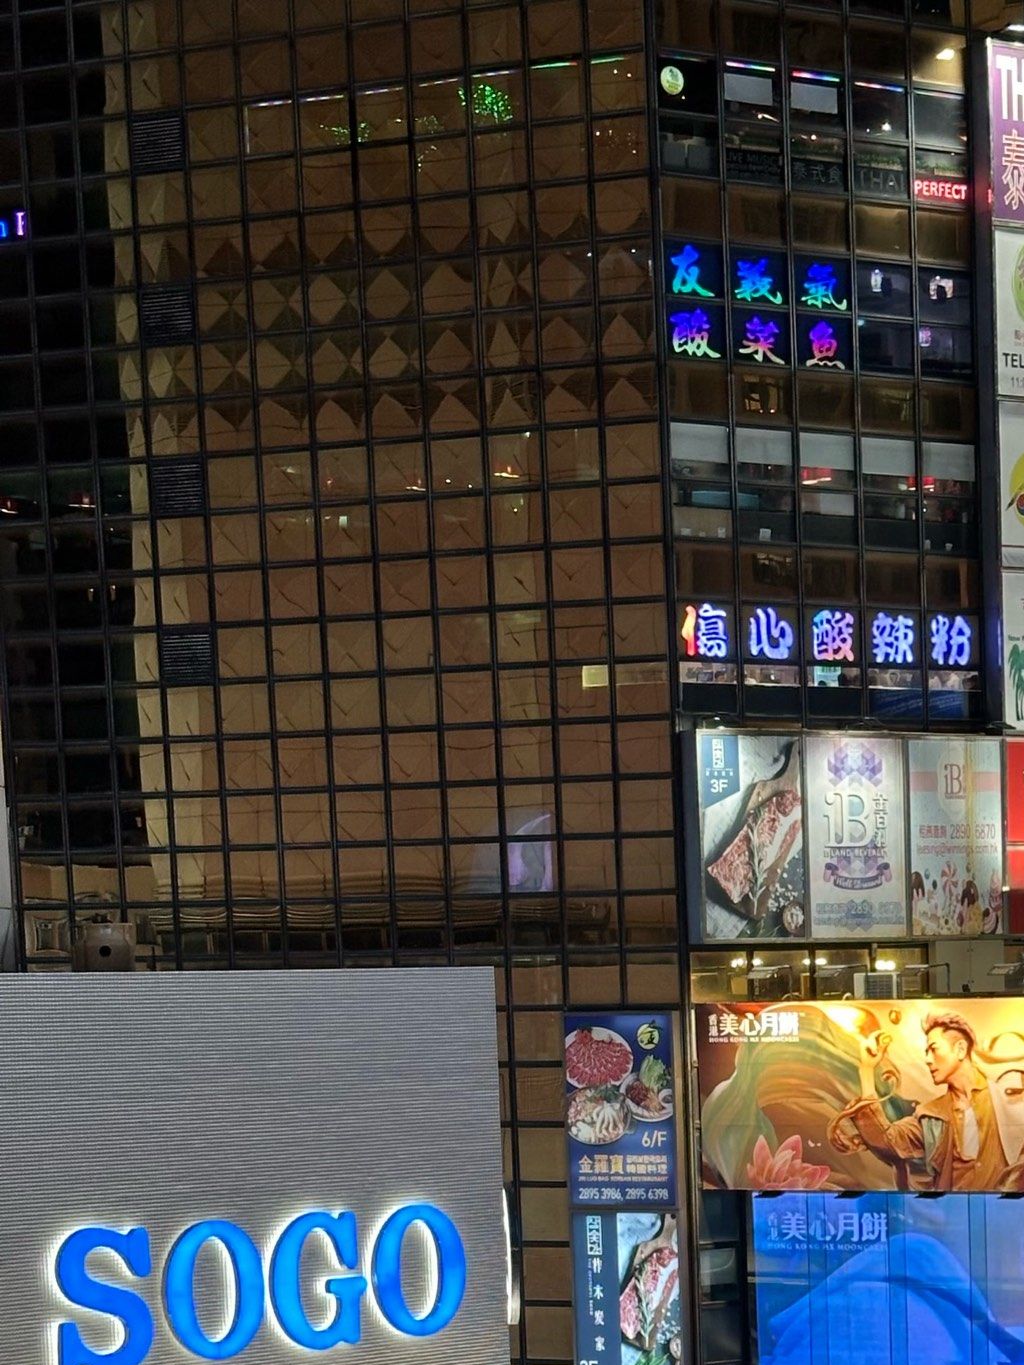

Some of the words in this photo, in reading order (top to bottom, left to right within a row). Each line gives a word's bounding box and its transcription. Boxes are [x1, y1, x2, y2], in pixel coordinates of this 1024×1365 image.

[914, 180, 967, 200] PERFECT
[670, 308, 847, 370] 酸菜魚
[681, 603, 972, 666] 傷心酸辣粉
[710, 778, 728, 792] 3F
[719, 1012, 799, 1036] 美心月餅
[641, 1131, 667, 1148] 6/F
[579, 1154, 624, 1174] 金羅寶
[579, 1187, 600, 1199] 2895
[625, 1188, 646, 1199] 2895
[648, 1188, 668, 1199] 6398
[781, 1211, 887, 1242] 美心月餅
